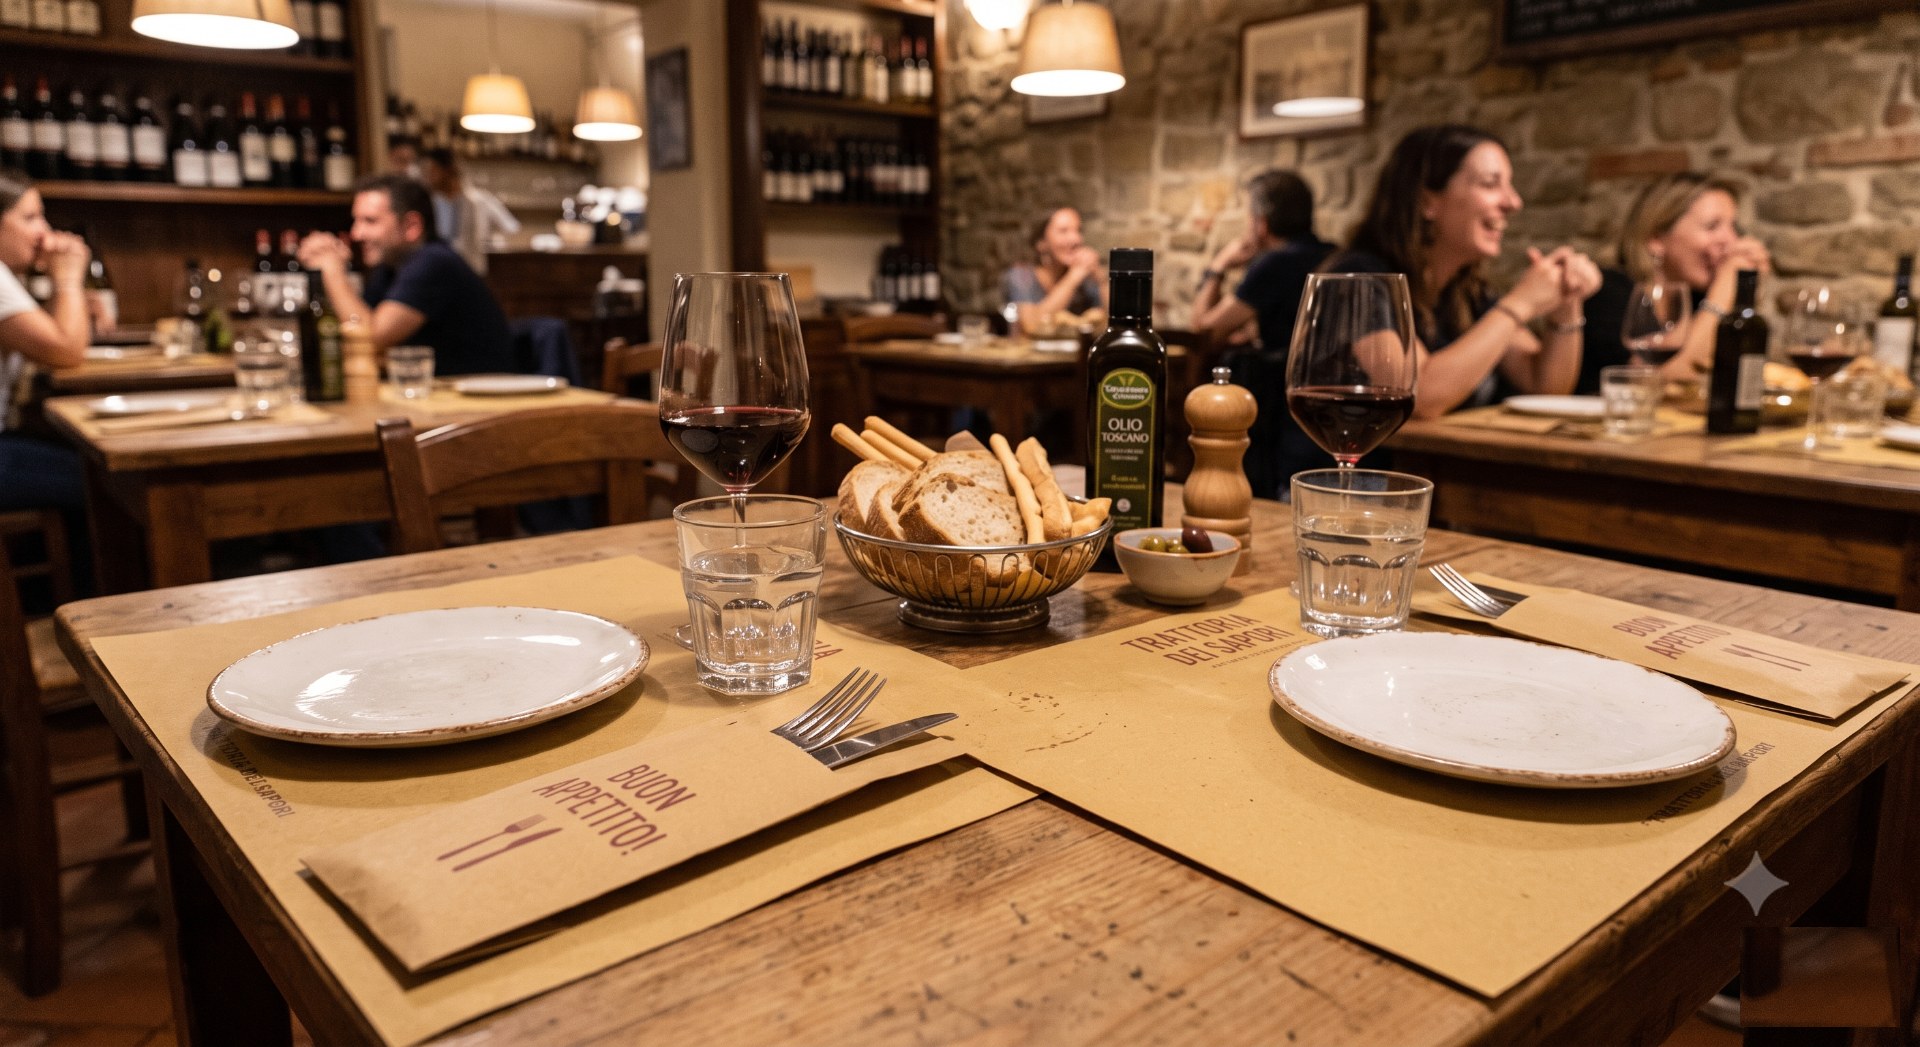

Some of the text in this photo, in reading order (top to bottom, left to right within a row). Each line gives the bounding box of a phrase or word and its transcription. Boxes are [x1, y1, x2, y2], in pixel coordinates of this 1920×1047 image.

[1101, 432, 1150, 443] TOSCANO
[1108, 418, 1143, 431] OLIO
[1120, 613, 1264, 653] TRATTORIA
[1163, 647, 1220, 666] DEI
[1203, 625, 1295, 654] SAPORI
[606, 764, 697, 812] BUON
[531, 777, 668, 856] APPETITO!
